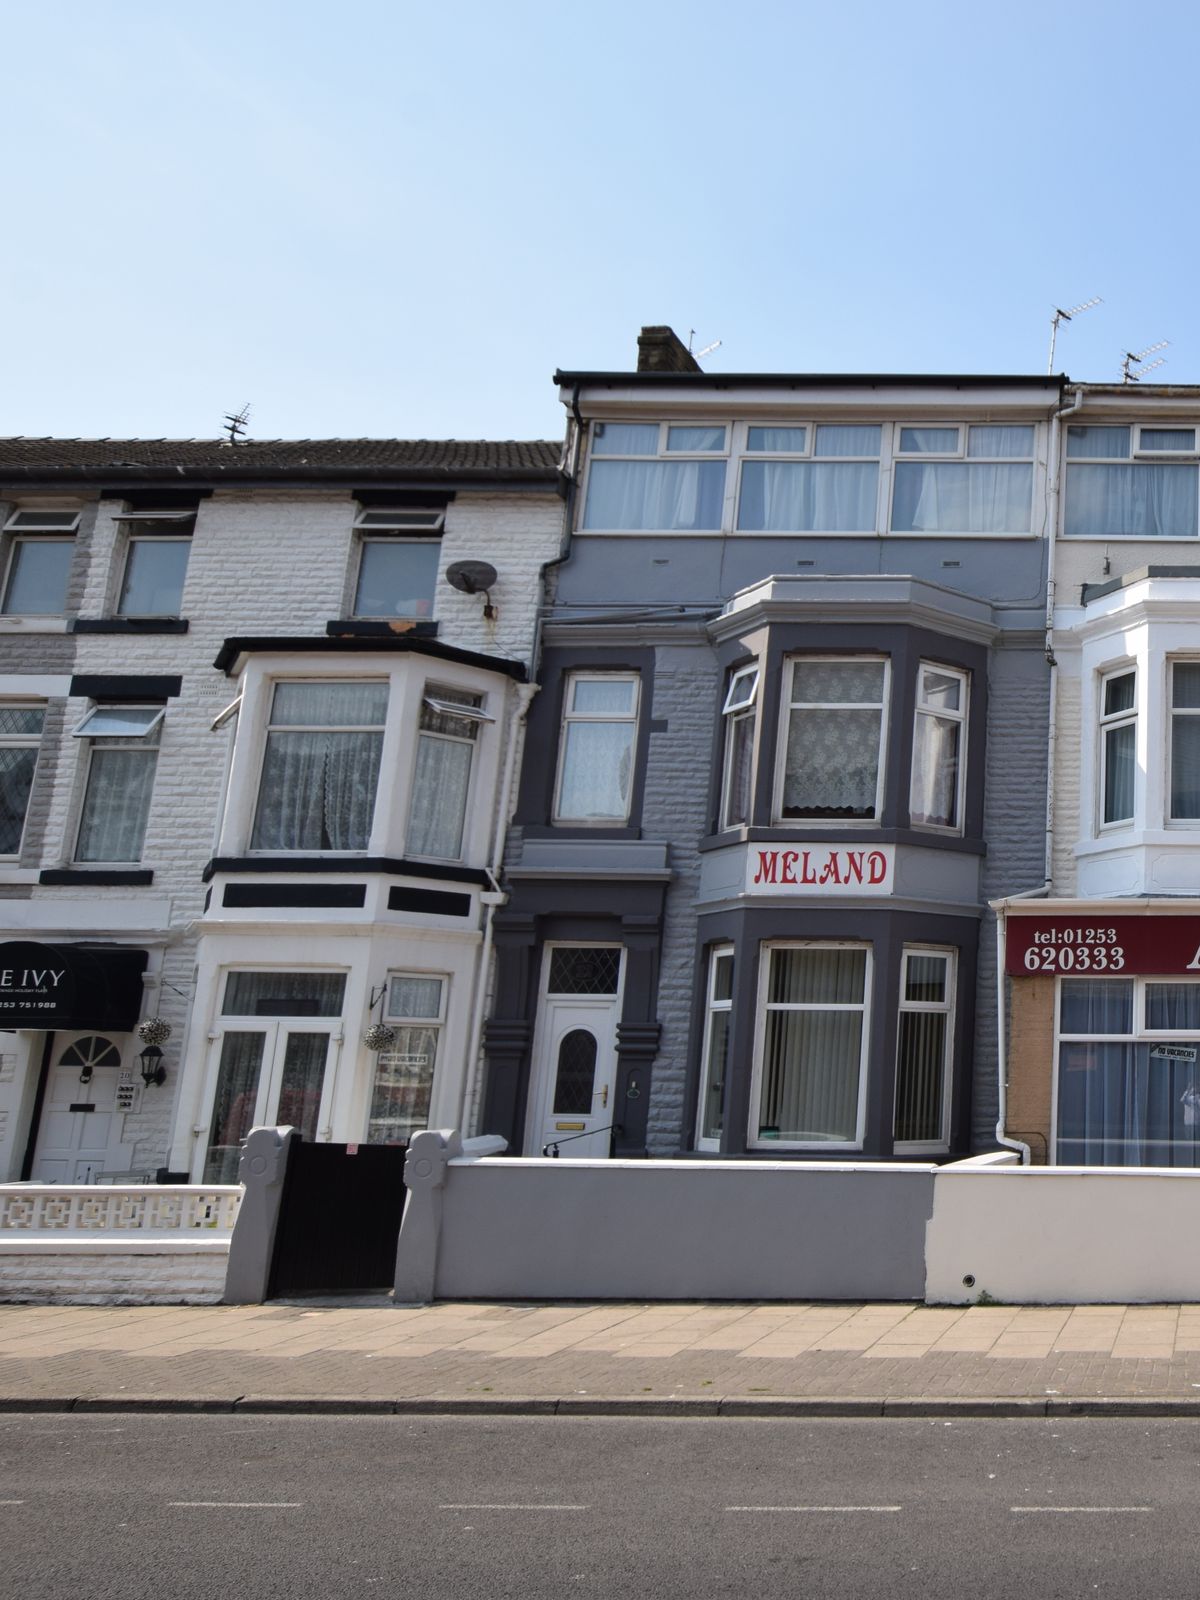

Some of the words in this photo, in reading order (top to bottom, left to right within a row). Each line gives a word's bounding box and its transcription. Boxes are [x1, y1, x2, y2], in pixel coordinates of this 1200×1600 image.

[754, 850, 887, 885] MELAND
[1034, 928, 1117, 944] tel:01253
[1024, 947, 1126, 972] 620333
[21, 969, 66, 987] IVY
